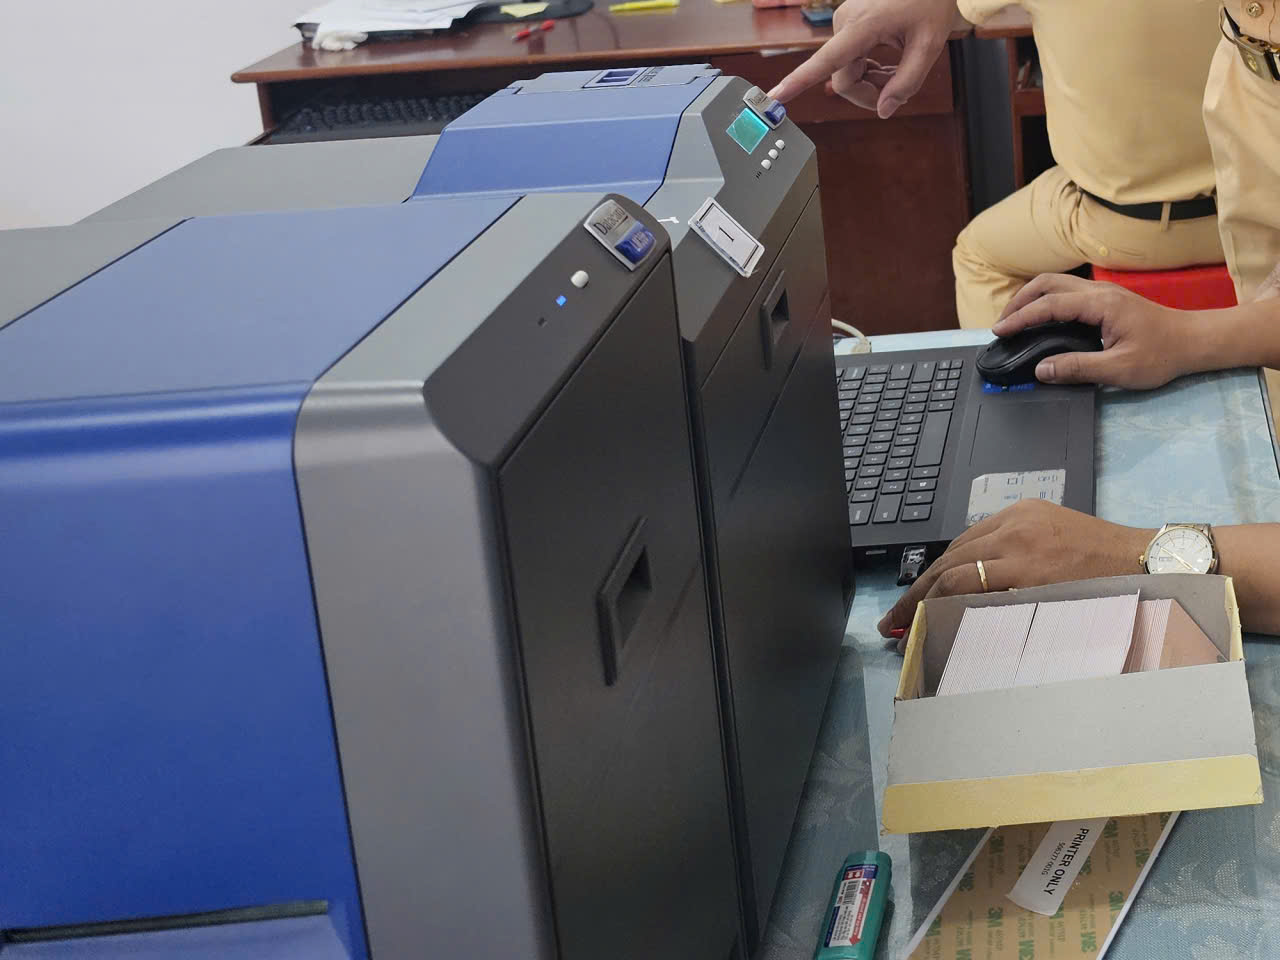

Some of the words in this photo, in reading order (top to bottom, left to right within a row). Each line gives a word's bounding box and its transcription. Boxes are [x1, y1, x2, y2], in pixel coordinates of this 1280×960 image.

[1062, 827, 1090, 867] PRINTER
[1045, 868, 1066, 895] ONLY
[1109, 891, 1124, 911] 3M
[988, 907, 1003, 928] 3M
[1082, 932, 1096, 953] 3M
